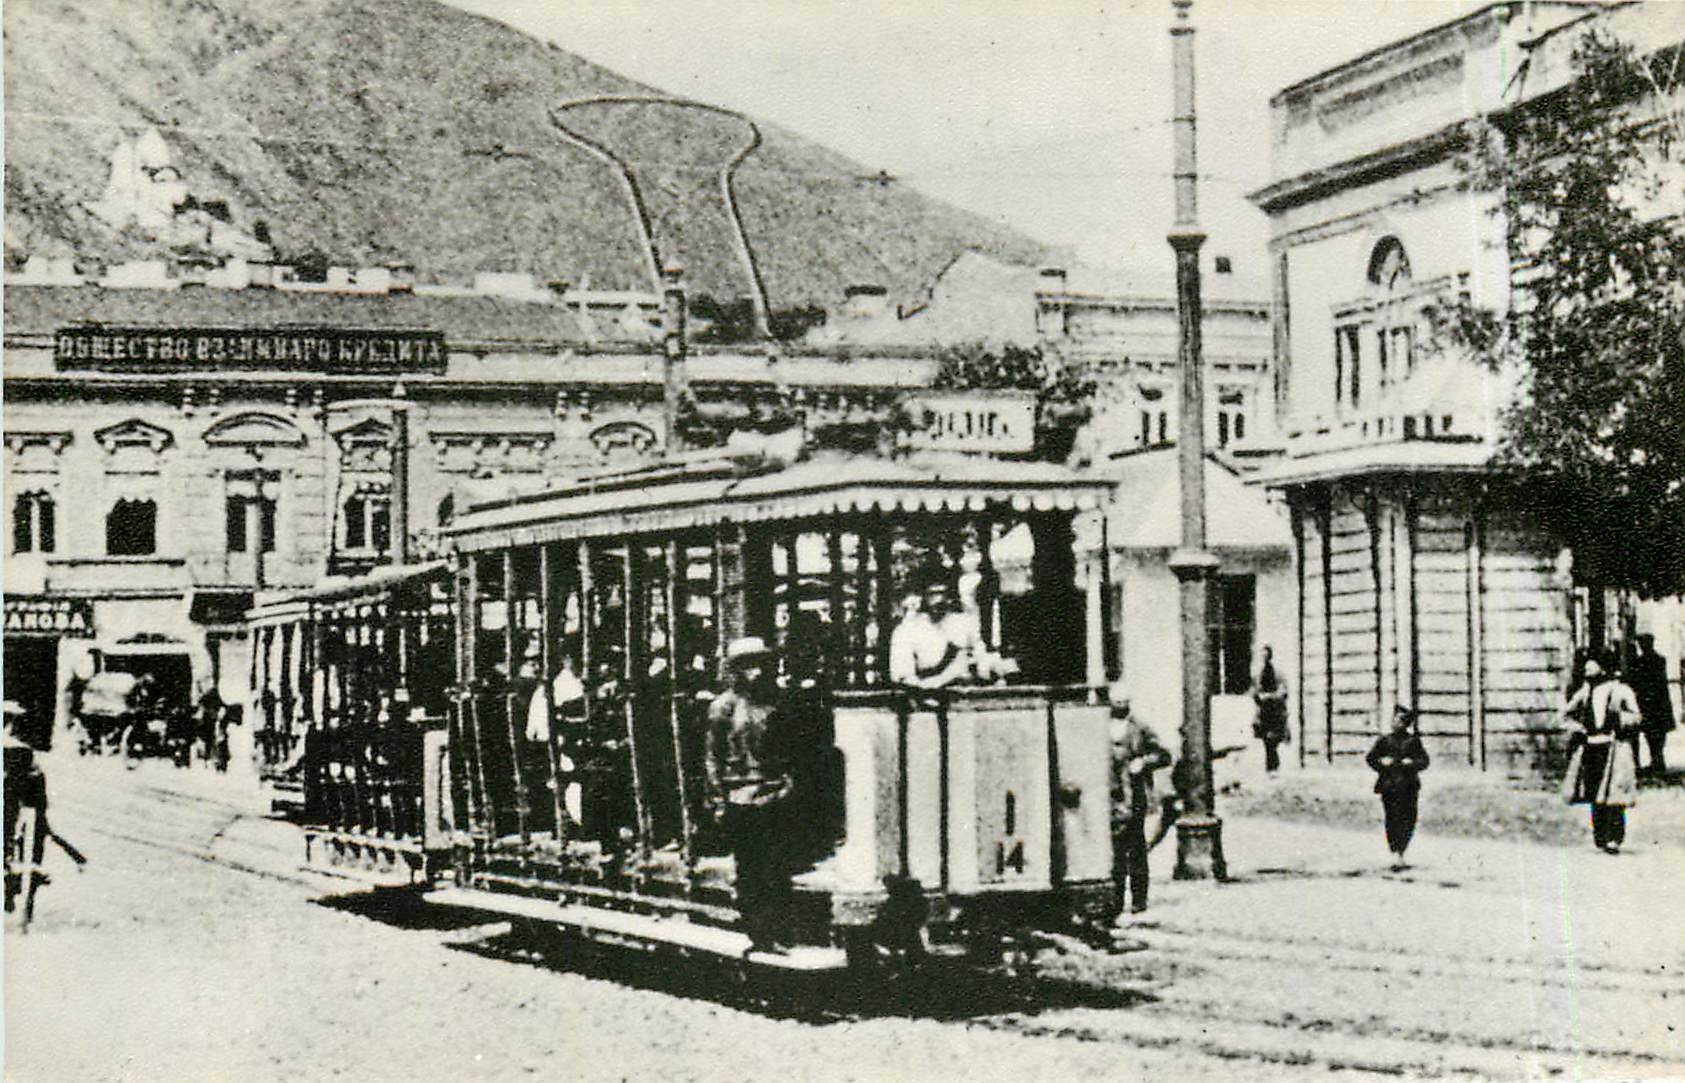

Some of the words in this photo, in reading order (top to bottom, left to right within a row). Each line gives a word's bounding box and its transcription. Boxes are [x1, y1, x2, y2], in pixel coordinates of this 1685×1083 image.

[59, 336, 189, 360] ОБЩЕСТВО
[339, 339, 440, 363] КРЕДИТА
[996, 841, 1028, 875] 14
